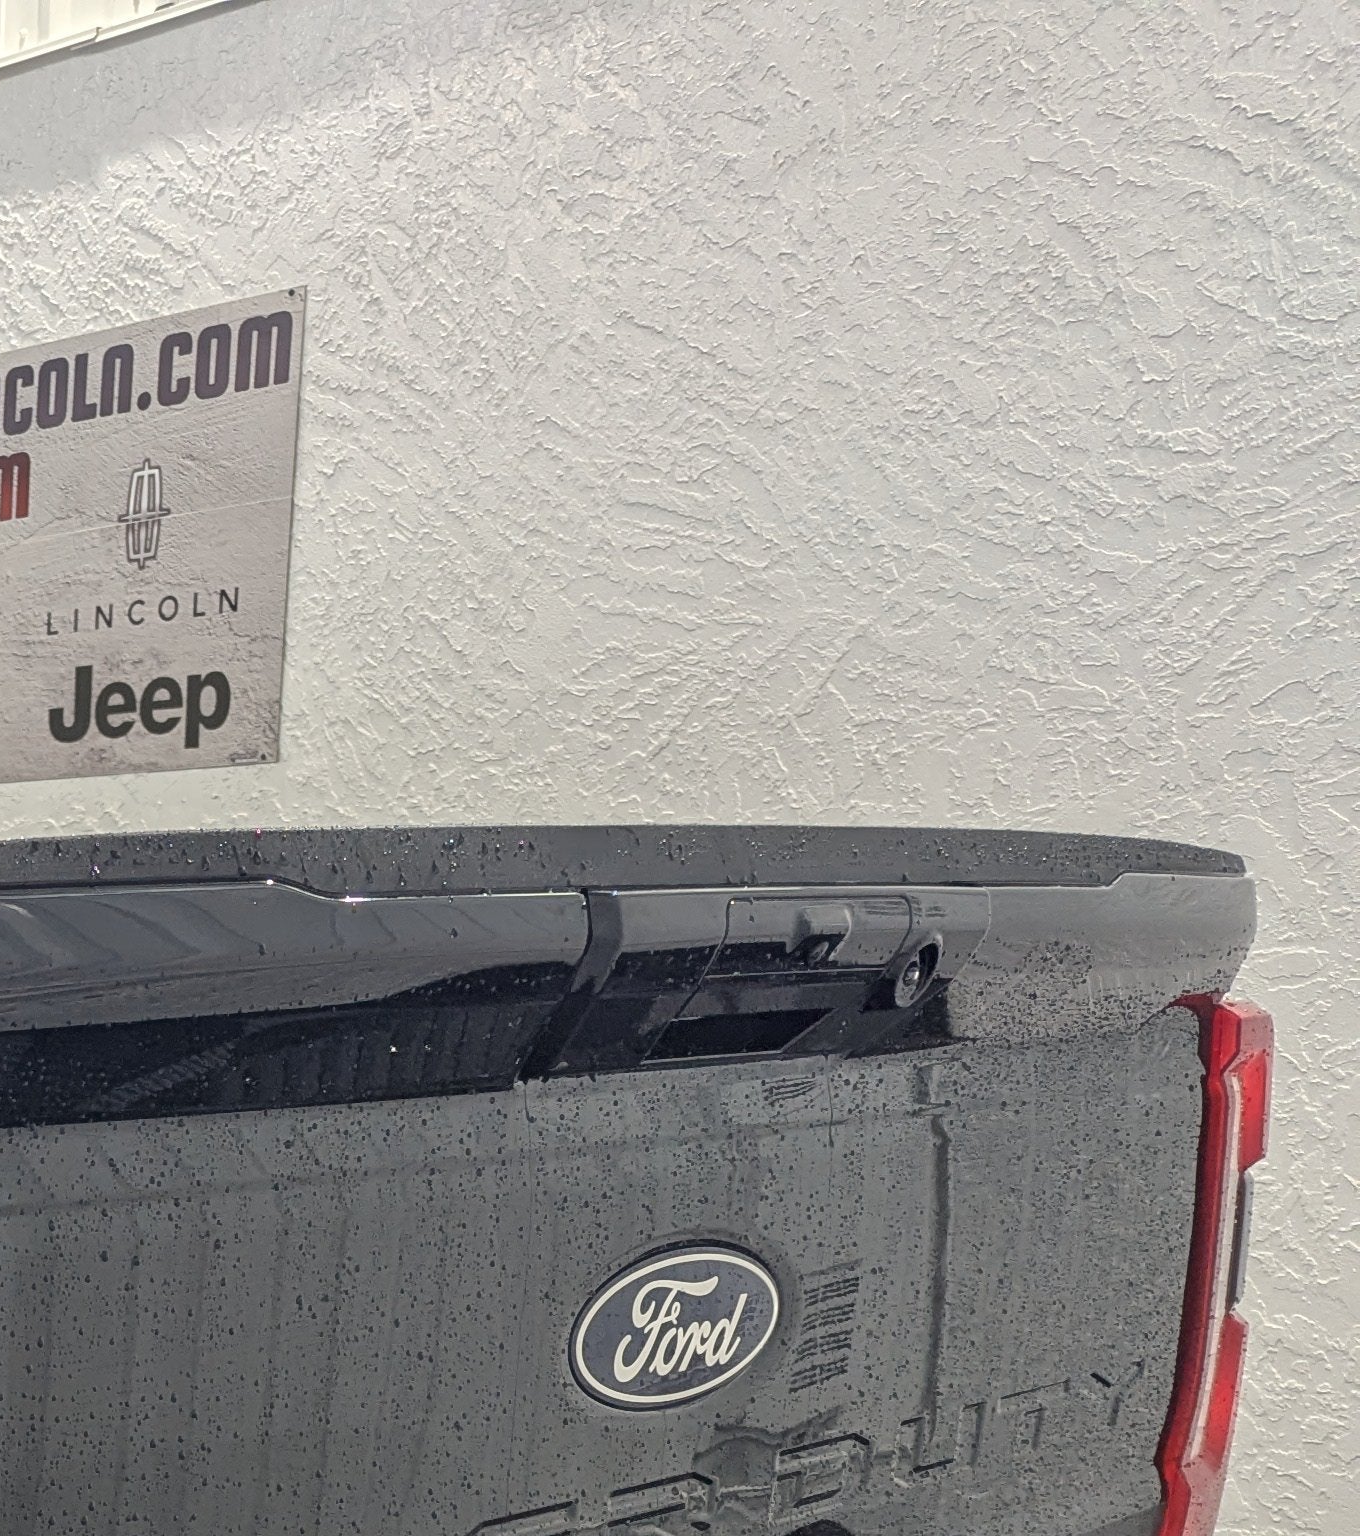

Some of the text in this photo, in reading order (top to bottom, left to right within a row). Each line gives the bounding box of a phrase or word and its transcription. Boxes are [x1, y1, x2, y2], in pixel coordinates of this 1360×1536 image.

[46, 587, 239, 636] LINCOLN
[48, 665, 231, 749] Jeep
[613, 1275, 748, 1383] Ford
